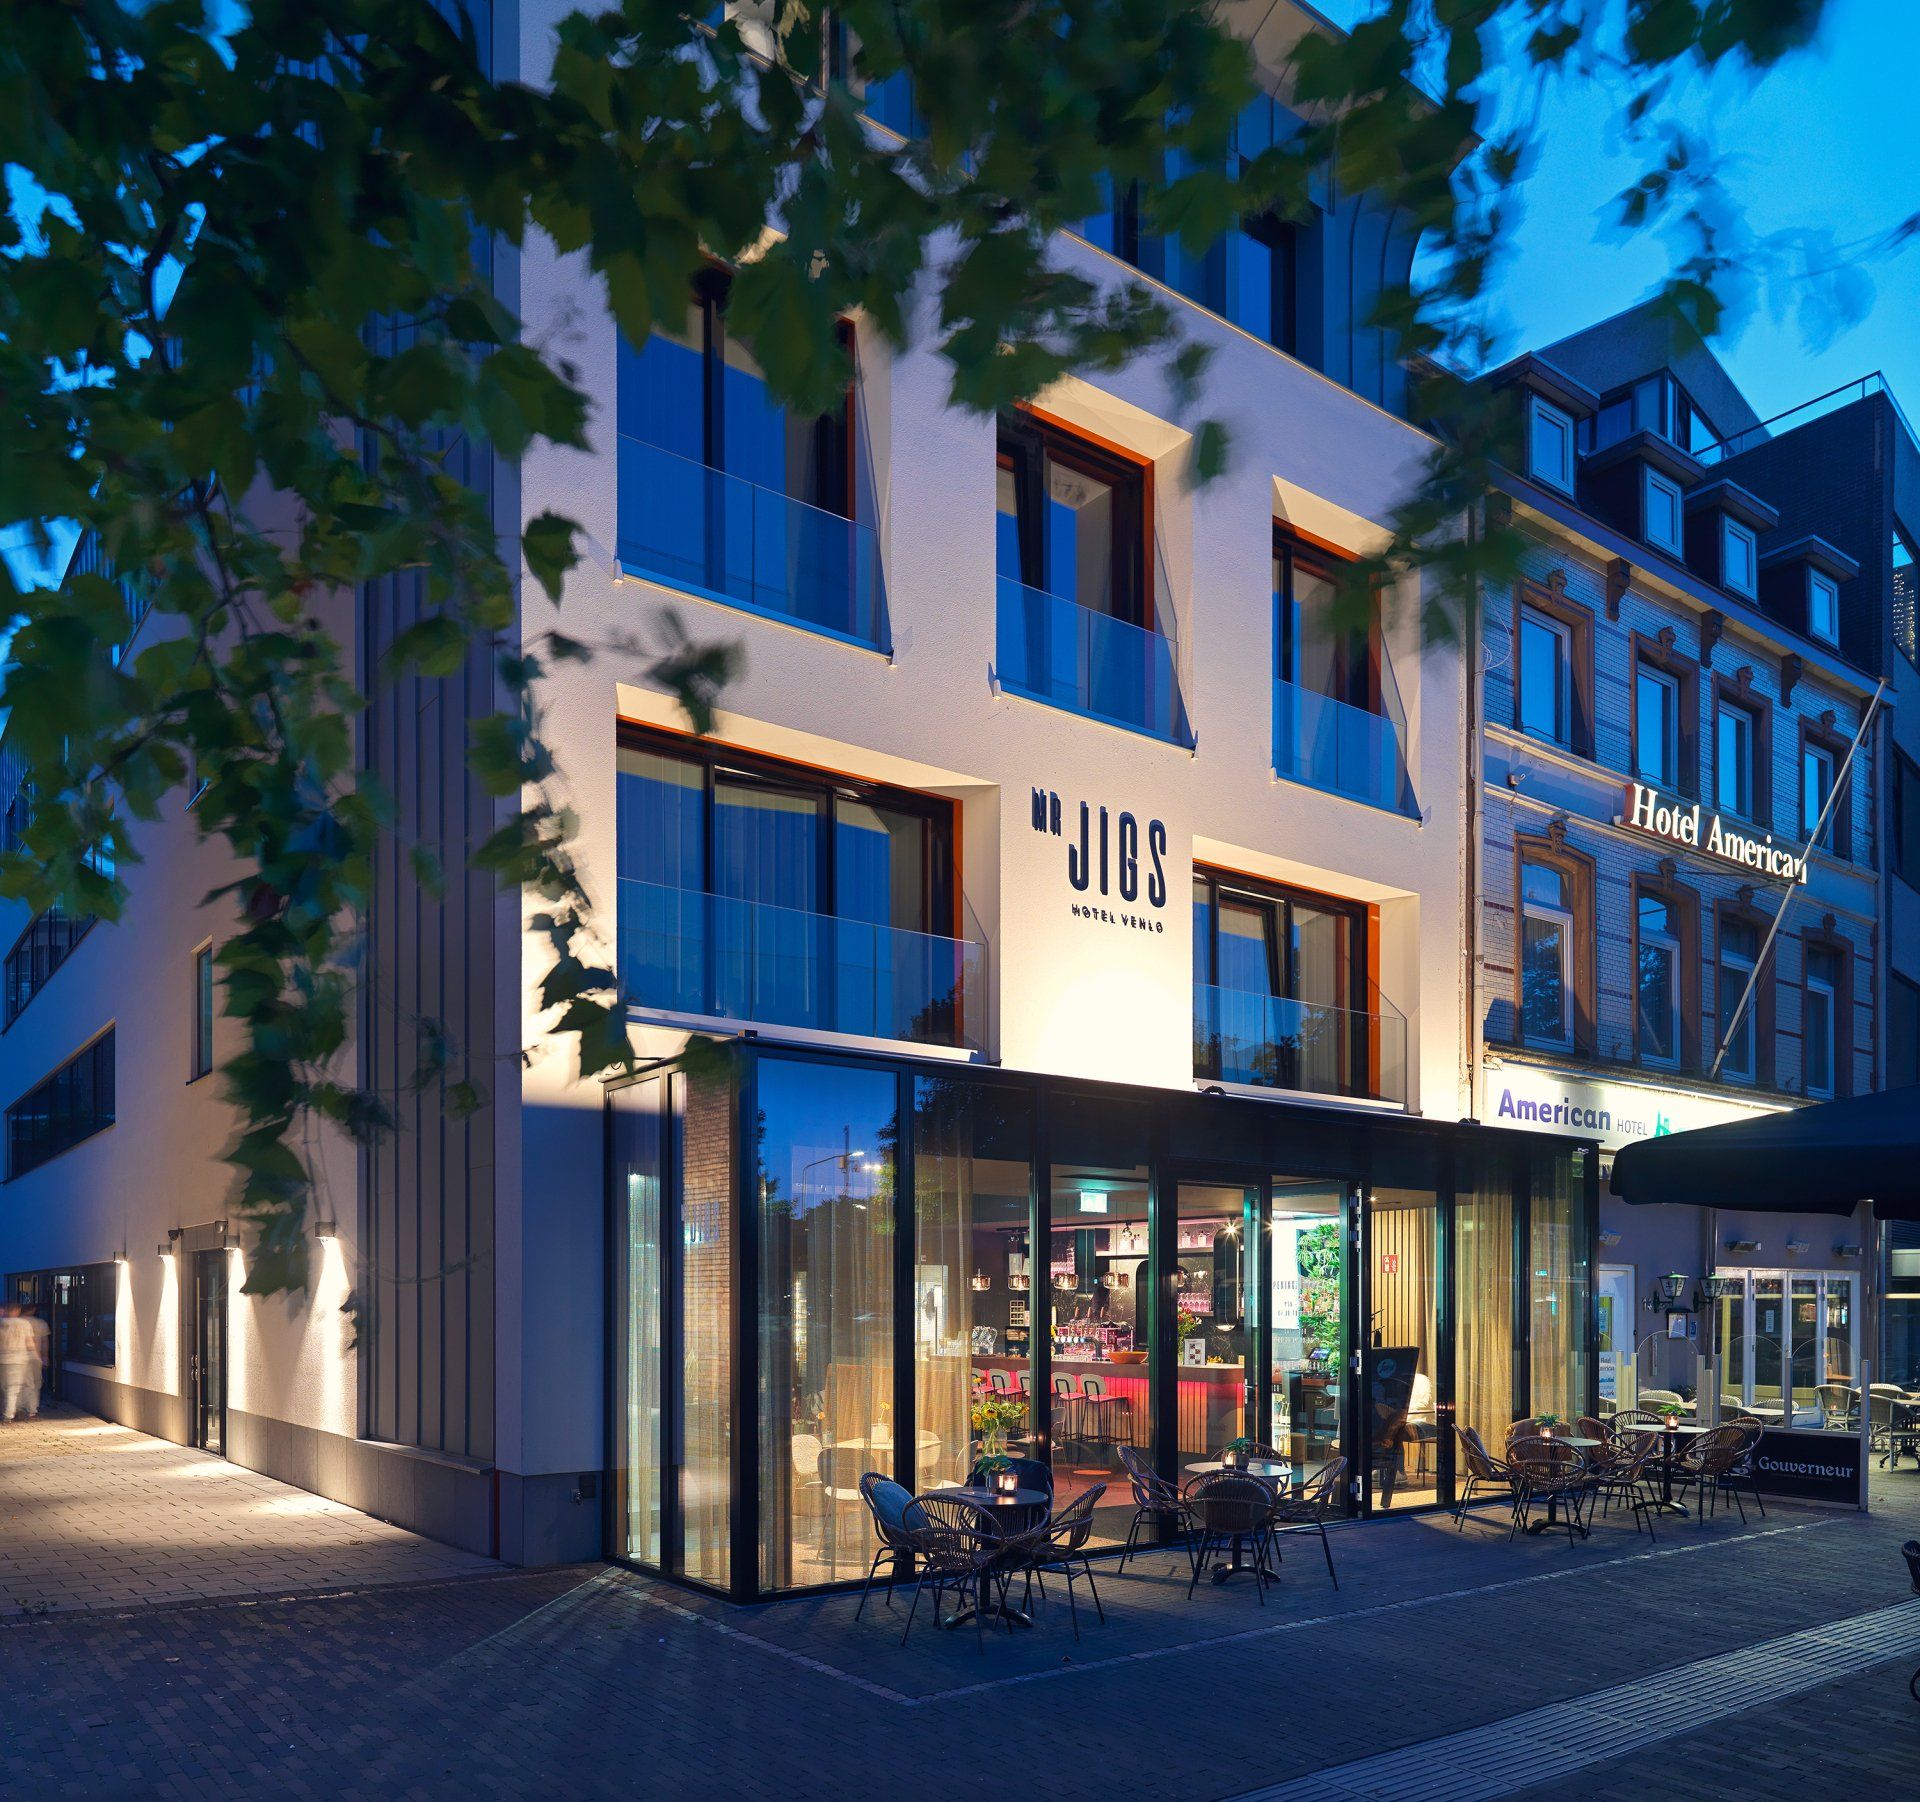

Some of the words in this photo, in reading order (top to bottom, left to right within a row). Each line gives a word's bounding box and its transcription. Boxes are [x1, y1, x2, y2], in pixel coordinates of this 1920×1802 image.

[1031, 786, 1062, 837] MR
[1630, 782, 1700, 847] Hotel
[1706, 814, 1808, 885] American
[1068, 800, 1167, 908] JIGS
[1071, 903, 1116, 924] HOTEL
[1121, 913, 1164, 934] VENLO
[1498, 1088, 1611, 1131] American
[1616, 1118, 1648, 1136] HOTEL
[1758, 1456, 1854, 1478] Gouverneur
